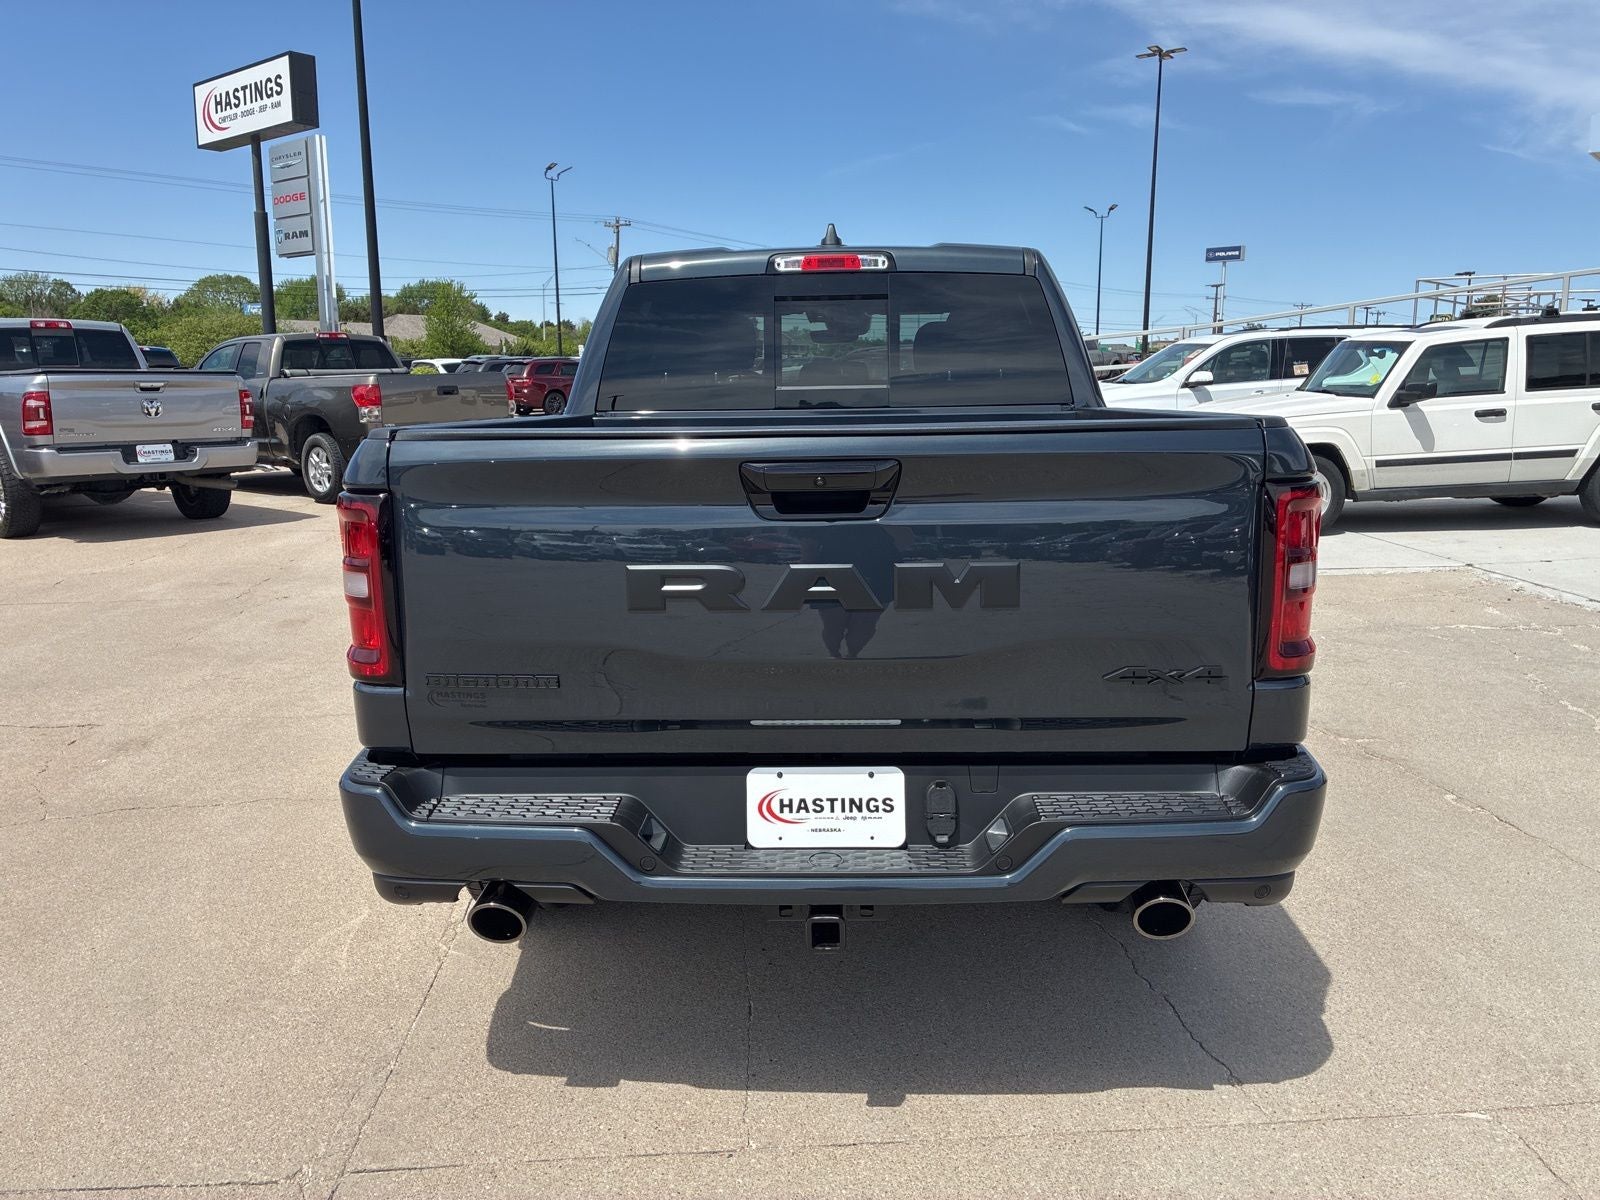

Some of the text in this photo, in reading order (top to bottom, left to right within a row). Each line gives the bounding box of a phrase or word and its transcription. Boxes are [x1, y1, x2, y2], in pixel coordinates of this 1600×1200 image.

[214, 74, 283, 114] HASTINGS
[271, 150, 302, 162] CHRYSLER
[273, 192, 306, 206] DODGE
[284, 229, 309, 241] RAM
[626, 563, 1021, 611] RAM
[436, 691, 487, 701] HASTINGS
[779, 797, 895, 814] HASTINGS
